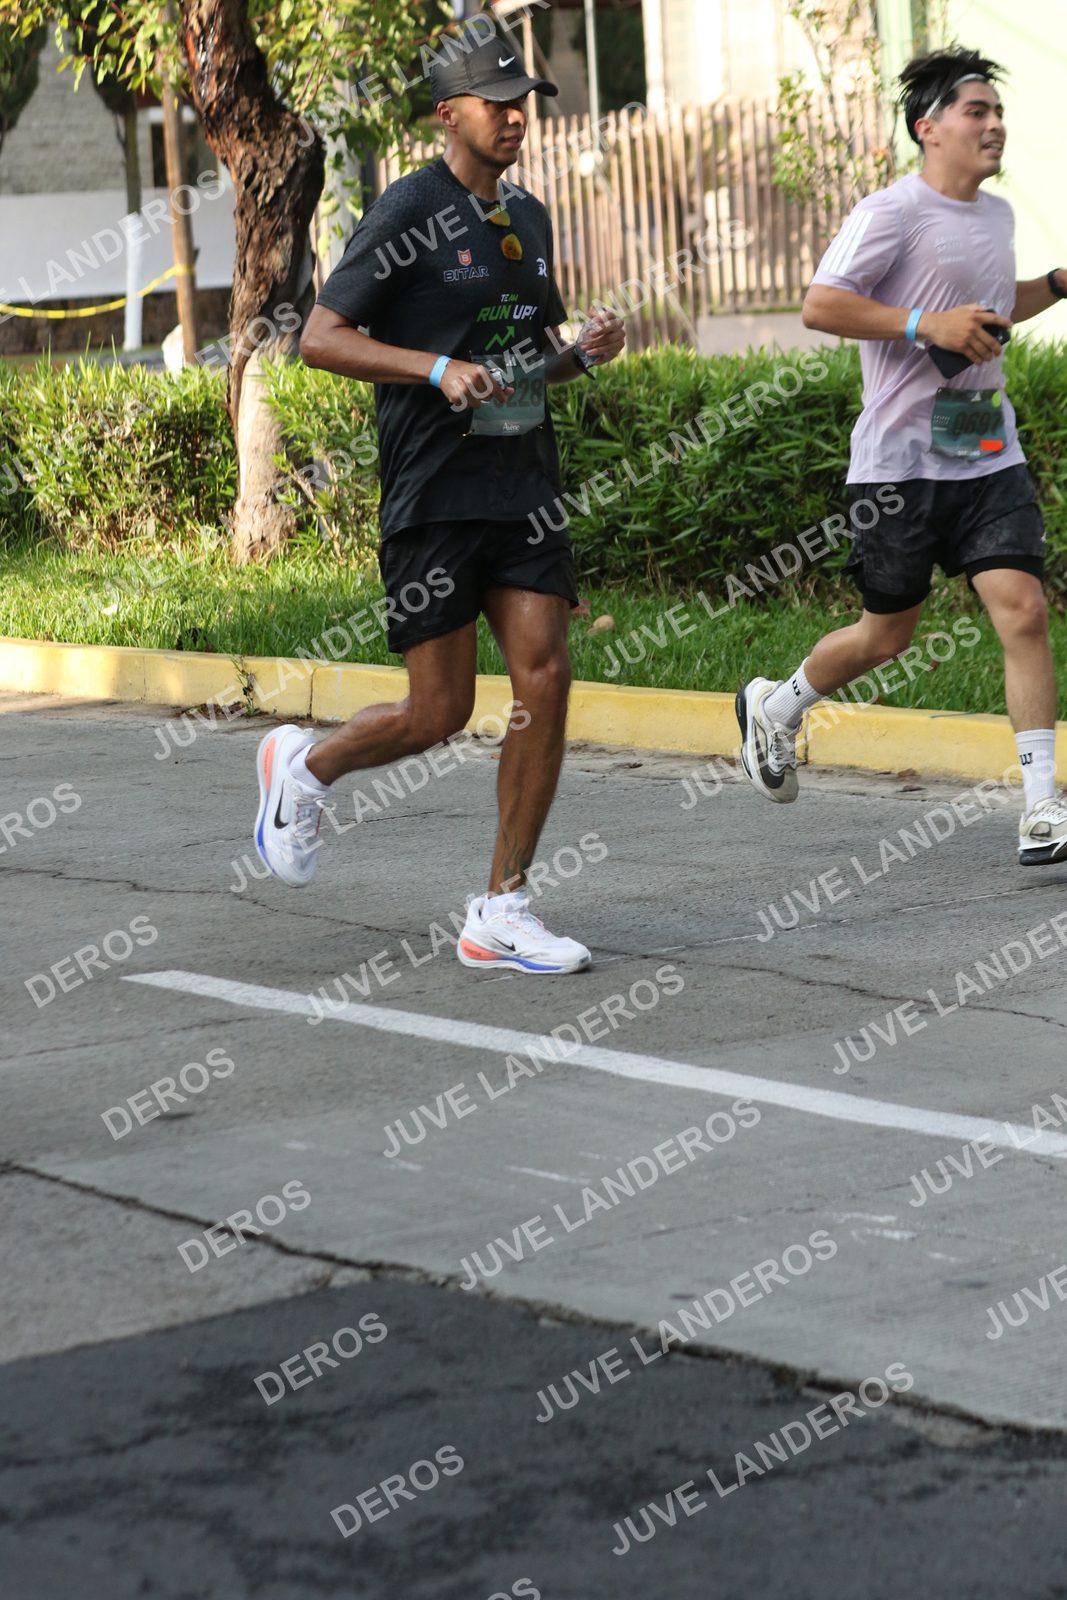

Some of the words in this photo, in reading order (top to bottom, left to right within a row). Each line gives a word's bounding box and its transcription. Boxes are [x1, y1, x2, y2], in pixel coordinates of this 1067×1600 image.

[443, 265, 490, 282] BITAR
[500, 293, 519, 303] TEAM
[476, 305, 511, 323] RUN
[513, 304, 538, 321] UP!
